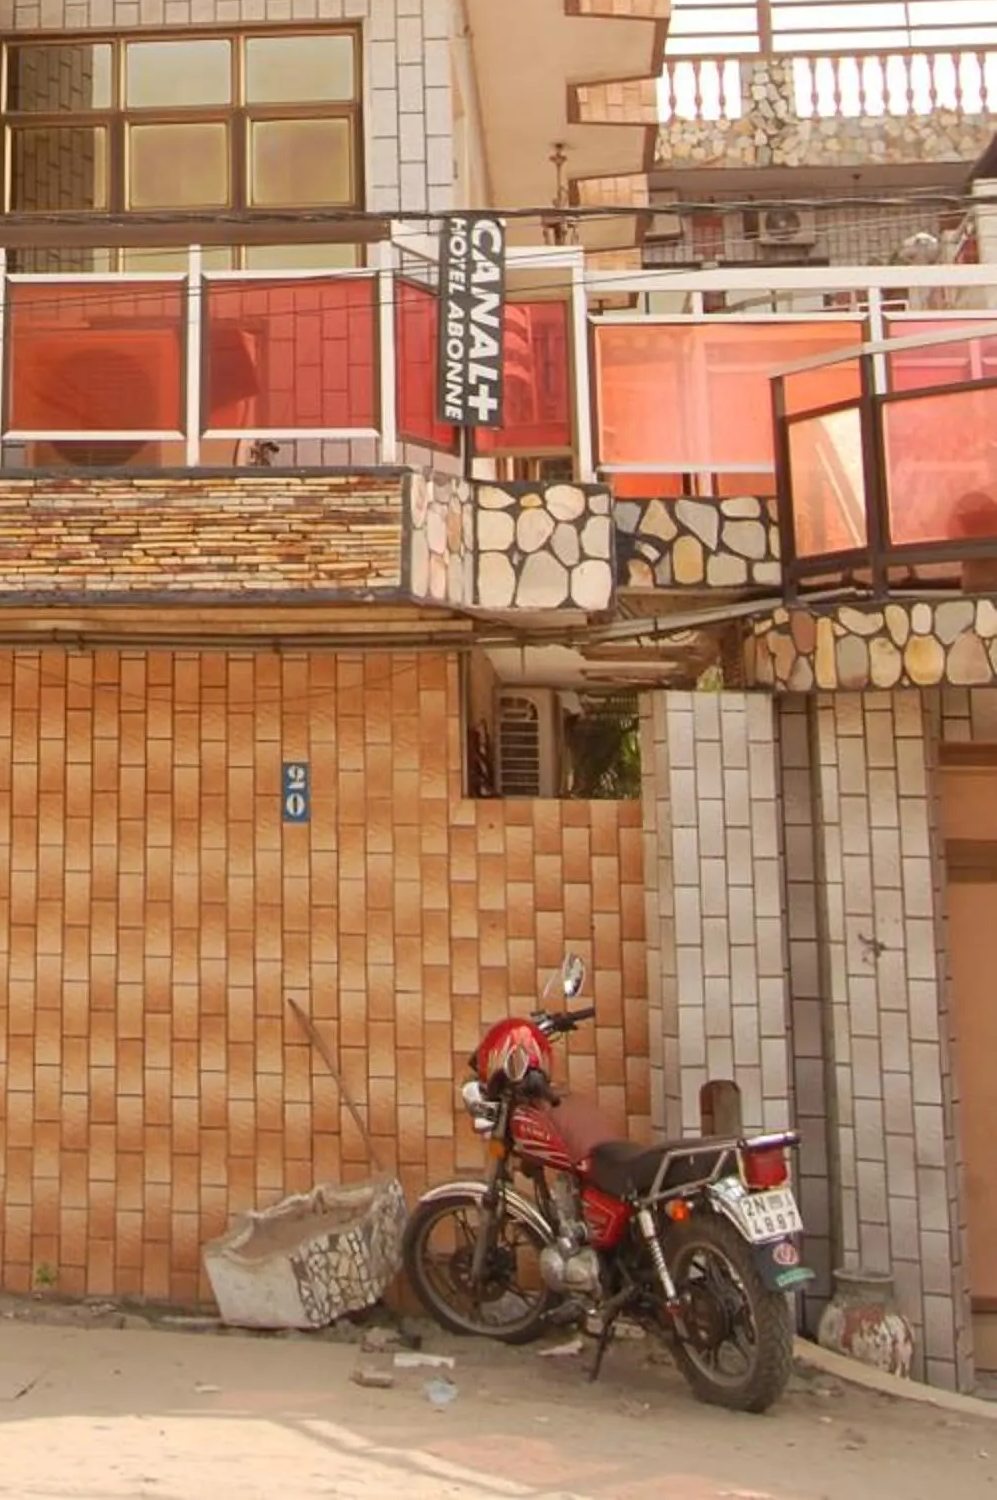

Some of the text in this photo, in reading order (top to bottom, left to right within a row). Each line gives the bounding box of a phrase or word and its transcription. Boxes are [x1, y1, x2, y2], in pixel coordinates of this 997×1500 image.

[445, 217, 468, 422] HOTEL ABONNE
[468, 218, 503, 422] CANAL+
